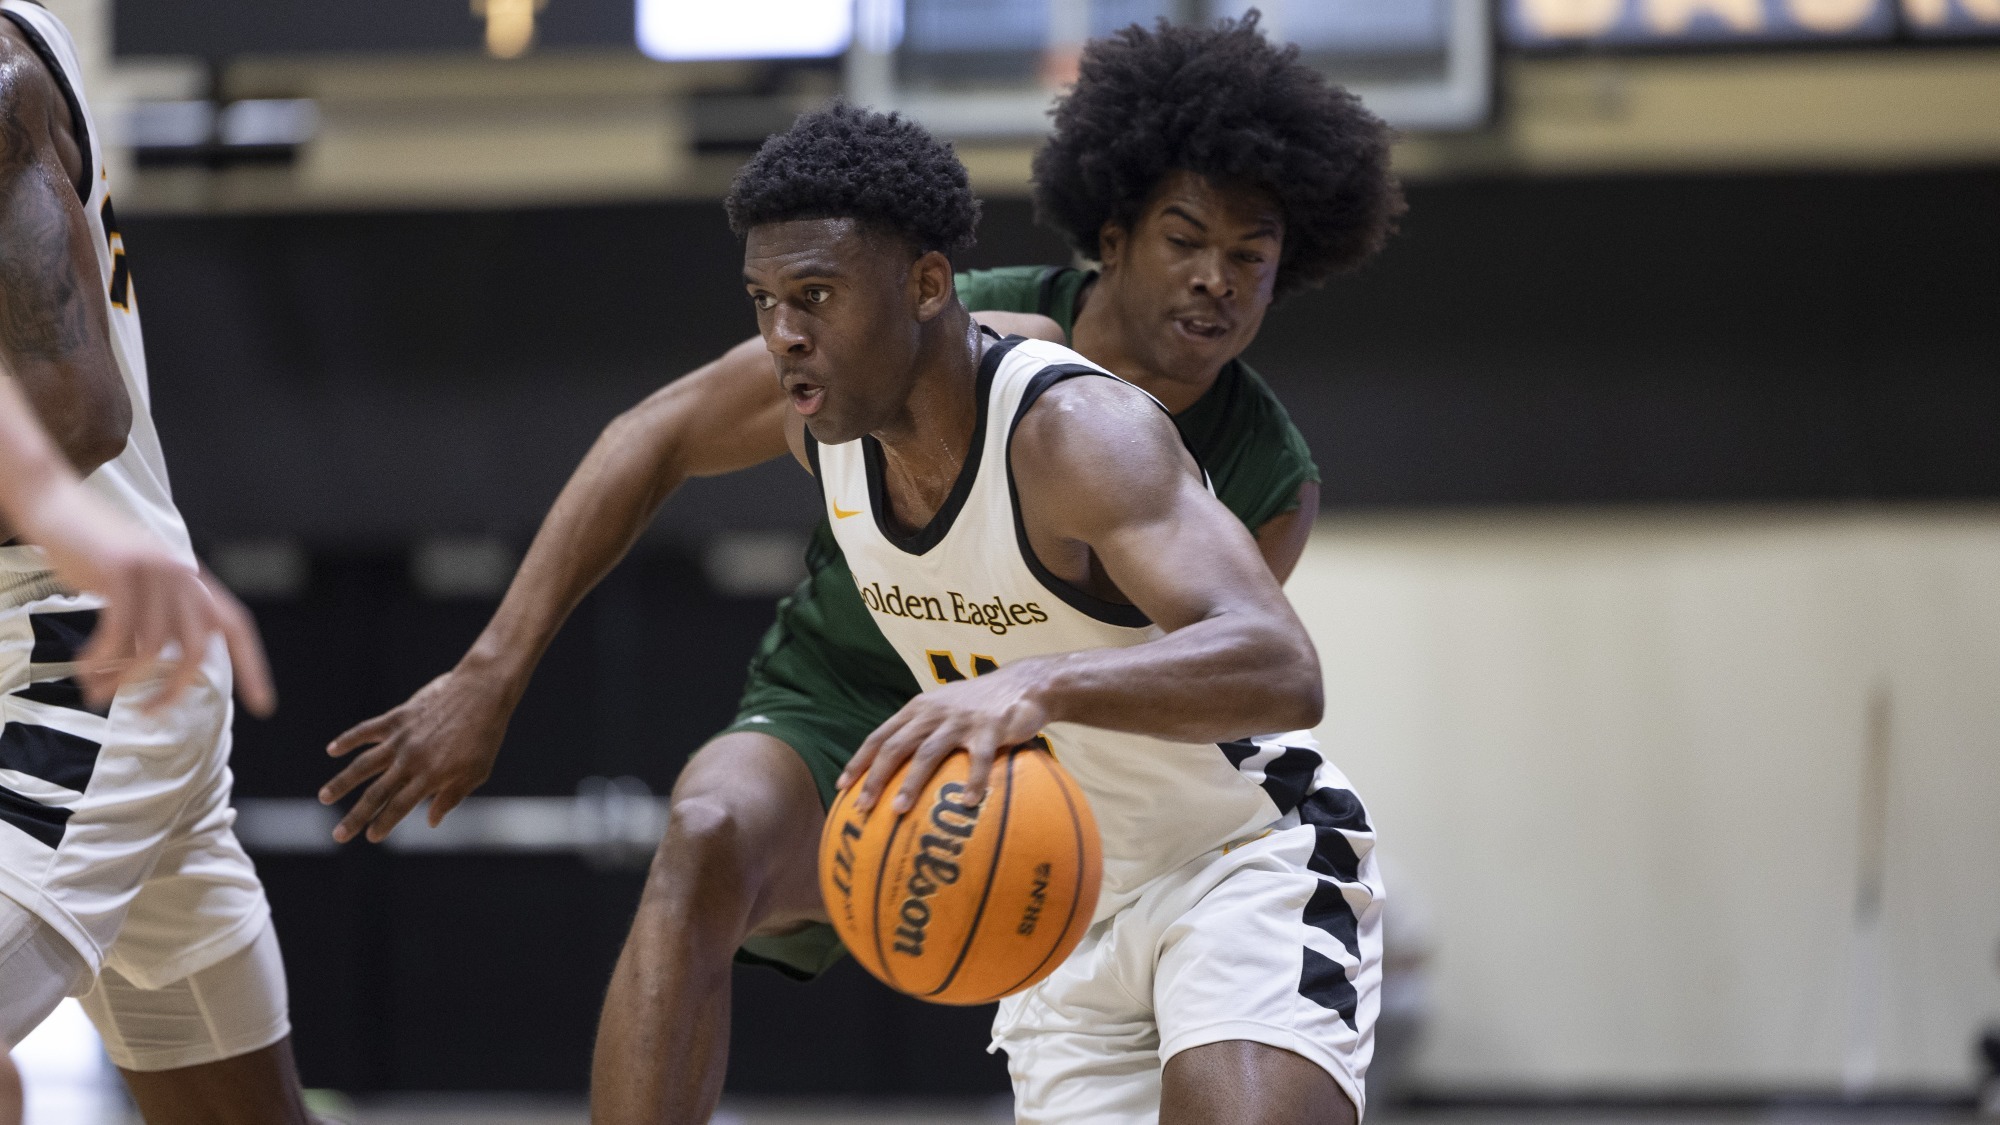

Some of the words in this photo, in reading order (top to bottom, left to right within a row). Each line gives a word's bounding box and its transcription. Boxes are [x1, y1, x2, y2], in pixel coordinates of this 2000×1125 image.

[853, 575, 948, 622] olden
[947, 590, 1049, 636] Eagles
[893, 782, 988, 958] Wilson
